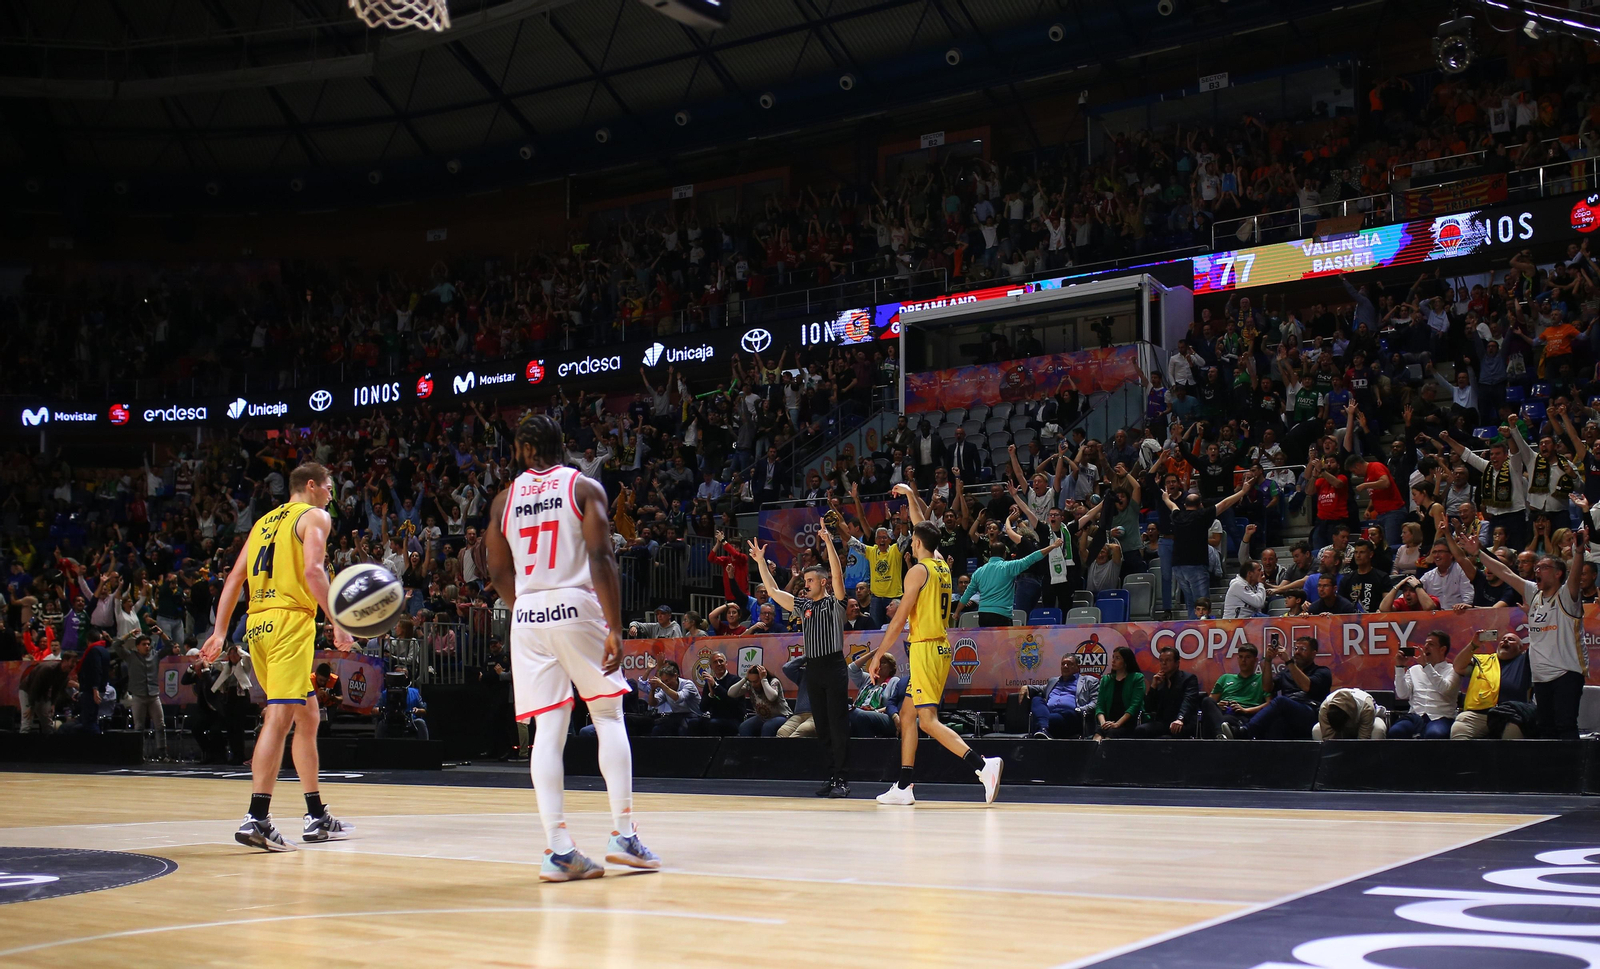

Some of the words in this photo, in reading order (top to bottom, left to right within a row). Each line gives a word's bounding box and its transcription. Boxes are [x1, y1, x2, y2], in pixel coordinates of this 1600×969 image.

[1201, 74, 1227, 83] SECTOR
[1209, 81, 1220, 89] B3
[1445, 197, 1481, 211] TRIPLE
[1301, 231, 1382, 258] VALENCIA
[1216, 253, 1256, 286] 77
[1313, 251, 1372, 274] BASKET
[666, 345, 714, 364] Unicaja
[557, 355, 621, 378] endesa
[479, 371, 516, 386] Movistar
[353, 381, 400, 406] IONOS
[54, 411, 97, 422] Movistar
[143, 405, 207, 422] endesa
[248, 401, 288, 418] Unicaja
[515, 498, 563, 517] PAMESA
[516, 603, 579, 624] Vitaldin
[940, 593, 949, 619] 9
[1150, 627, 1248, 660] COPA
[1343, 620, 1417, 656] REY
[1076, 653, 1107, 666] BAXI
[350, 681, 367, 692] BAXI
